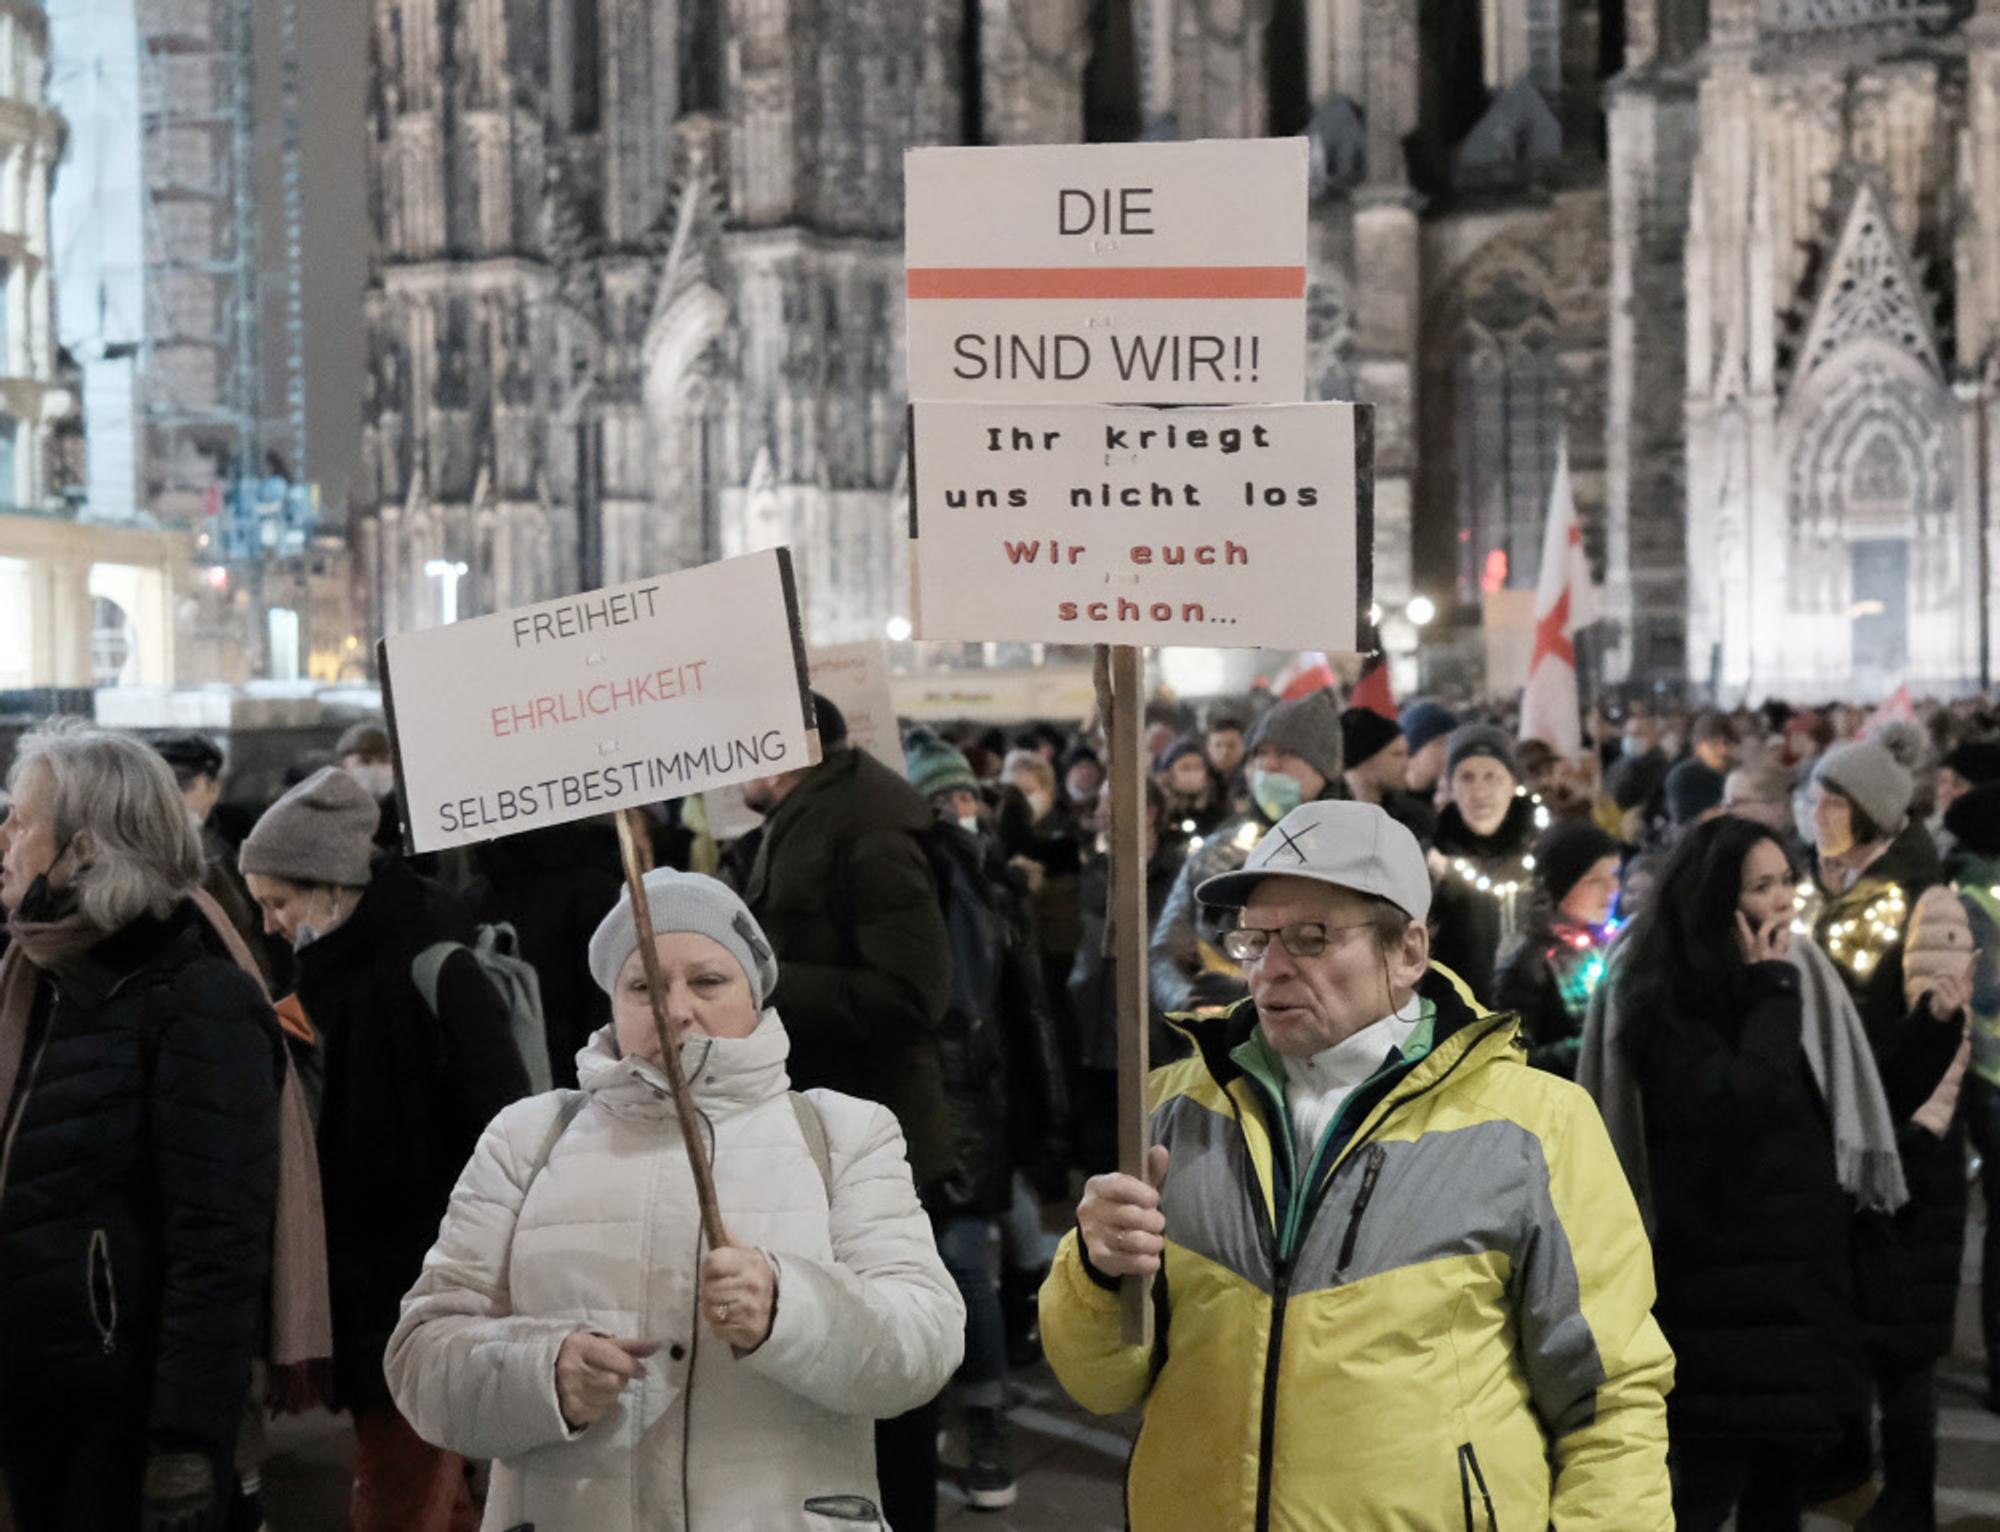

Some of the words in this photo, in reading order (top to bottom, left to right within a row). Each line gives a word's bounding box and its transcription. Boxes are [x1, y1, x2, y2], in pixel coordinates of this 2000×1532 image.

[1058, 187, 1155, 236] DIE
[952, 333, 1092, 382] SIND
[1109, 334, 1260, 383] WIR!!
[986, 426, 1062, 452] Ihr
[1104, 423, 1271, 454] kriegt
[944, 487, 1028, 509] uns
[1069, 481, 1202, 508] nicht
[1244, 481, 1319, 508] los
[1002, 539, 1087, 566] Wir
[1129, 539, 1249, 566] euch
[512, 586, 660, 648] FREIHEIT
[1057, 596, 1238, 625] schon...
[491, 660, 708, 737] EHRLICHKEIT
[439, 729, 788, 833] SELBSTBESTIMMUNG
